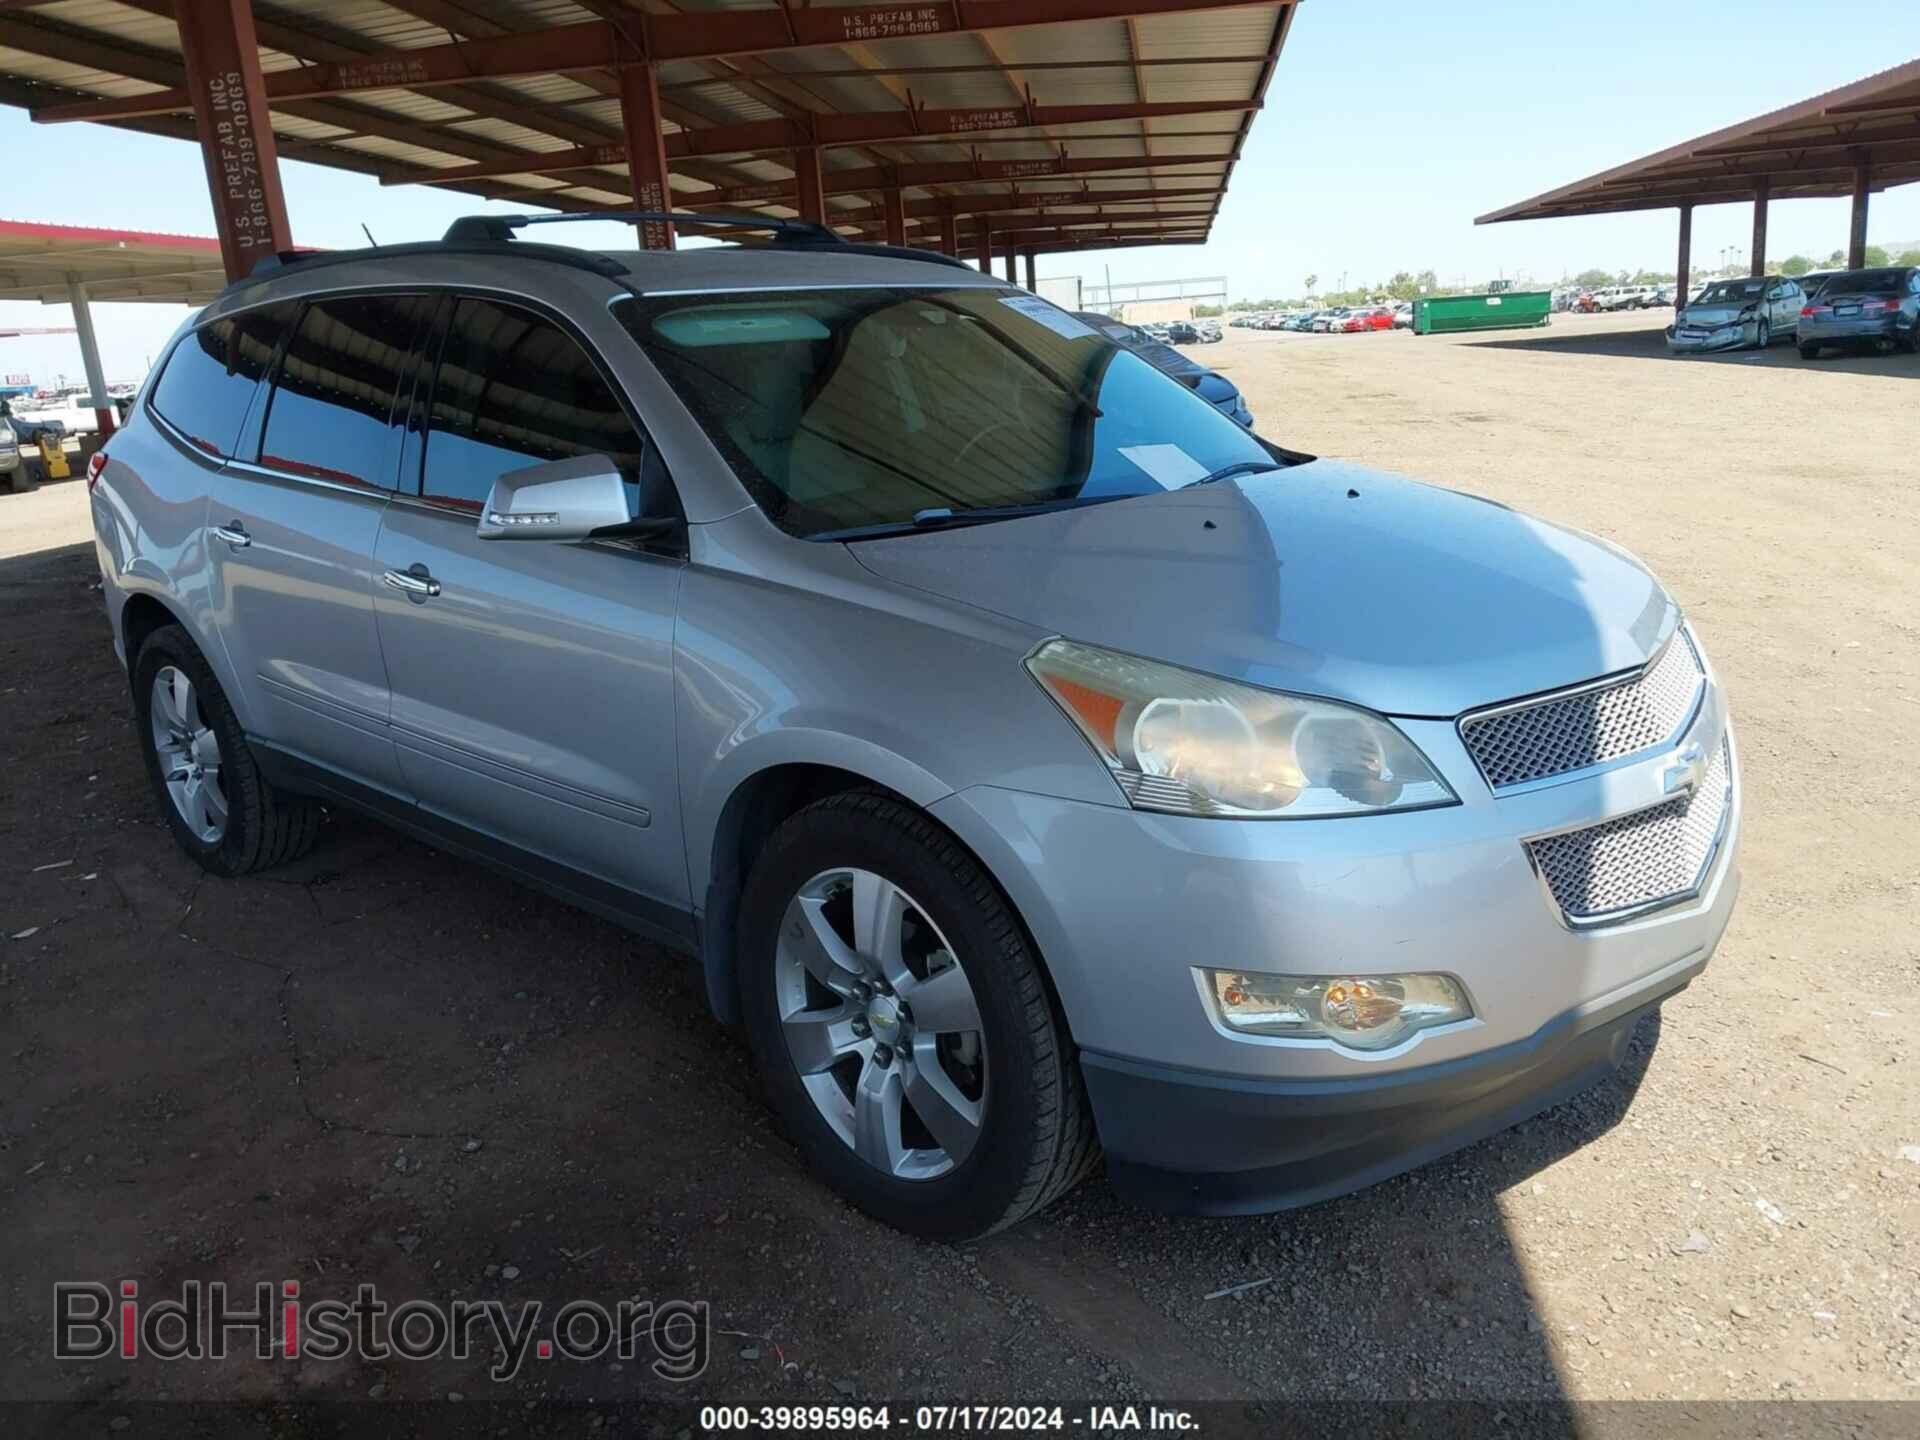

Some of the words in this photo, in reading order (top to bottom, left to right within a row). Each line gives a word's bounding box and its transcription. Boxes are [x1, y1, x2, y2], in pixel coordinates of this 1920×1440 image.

[843, 15, 865, 26] U.S.
[870, 10, 913, 25] PREFAB
[209, 72, 227, 110] INC.
[217, 120, 244, 199] PREFAB
[226, 72, 272, 245] 1-866-799-0969
[235, 210, 254, 248] U.S.
